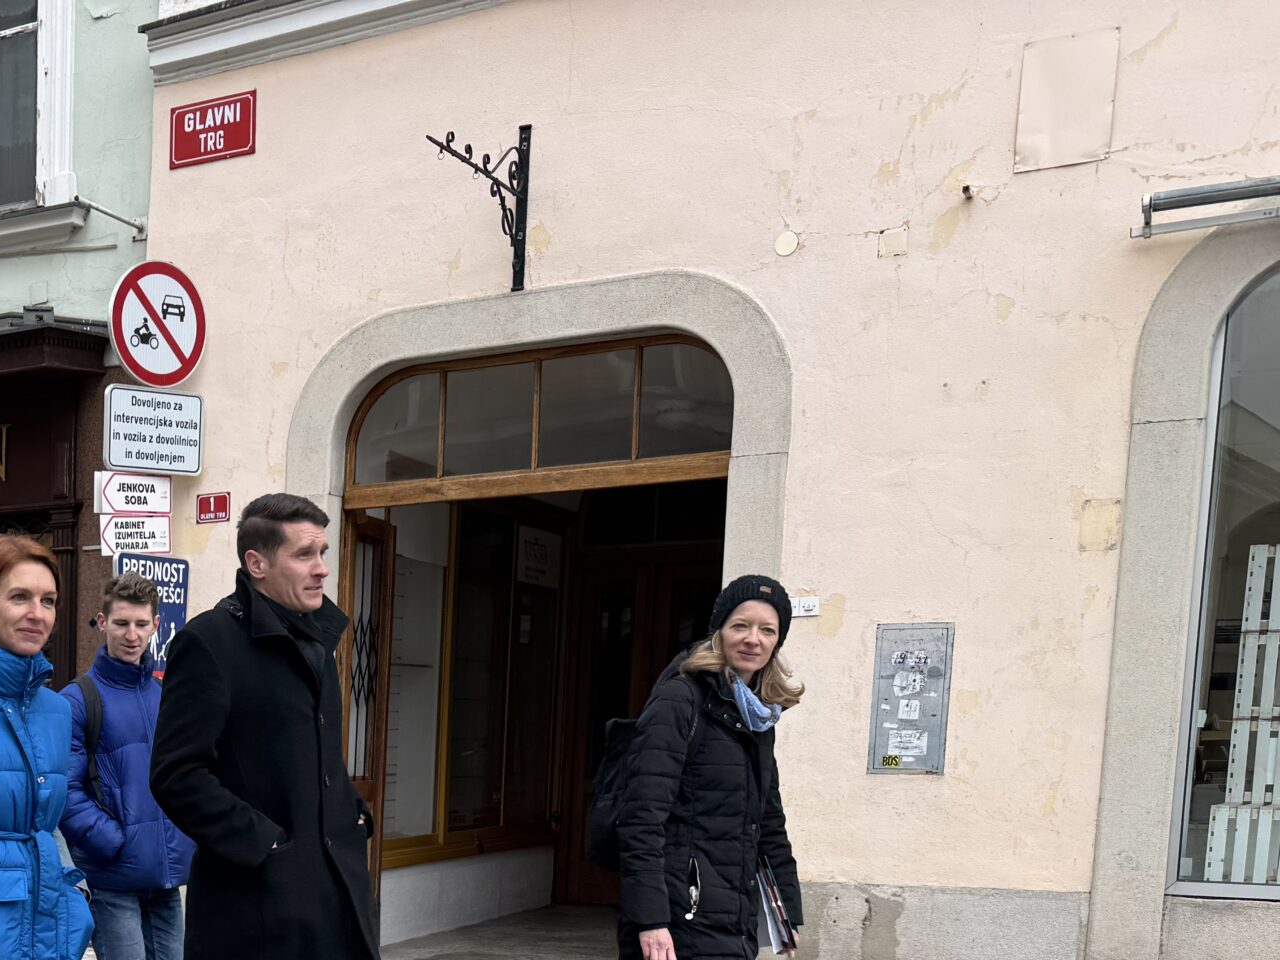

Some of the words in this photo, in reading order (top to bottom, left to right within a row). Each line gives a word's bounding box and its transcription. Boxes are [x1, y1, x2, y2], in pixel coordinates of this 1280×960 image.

[184, 102, 241, 133] GLAVNI
[199, 130, 224, 153] TRG
[131, 395, 172, 411] Dovoljeno
[173, 402, 183, 411] za
[113, 411, 173, 429] intervencijska
[175, 419, 198, 430] vozila
[112, 429, 121, 440] in
[123, 432, 147, 443] vozila
[155, 434, 198, 447] dovolilnico
[125, 448, 133, 459] in
[135, 449, 185, 465] dovoljenjem
[116, 482, 156, 494] JENKOVA
[124, 495, 149, 506] SOBA
[209, 496, 215, 512] 1
[114, 521, 146, 530] KABINET
[114, 530, 156, 540] IZUMITELJA
[115, 541, 149, 551] PUHARJA
[122, 558, 186, 584] PREDNOST
[157, 582, 185, 604] PEŠCI
